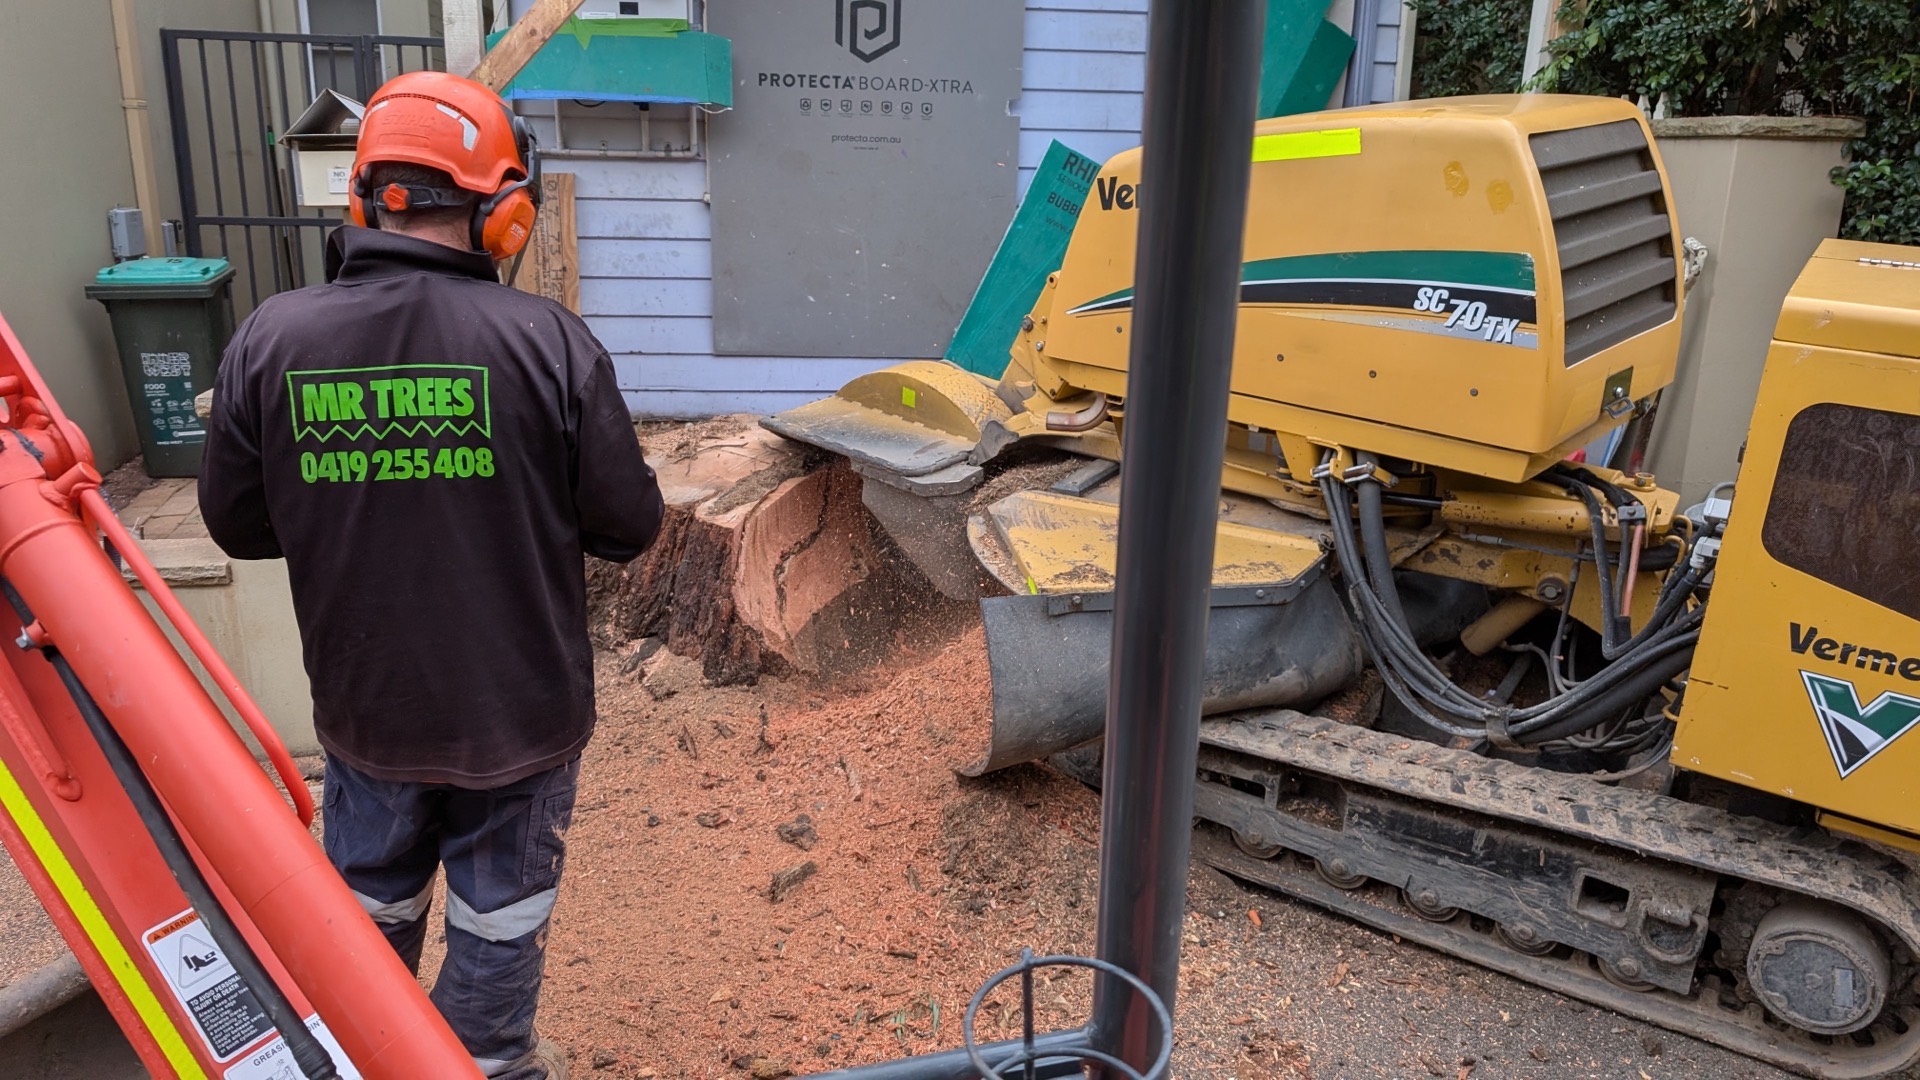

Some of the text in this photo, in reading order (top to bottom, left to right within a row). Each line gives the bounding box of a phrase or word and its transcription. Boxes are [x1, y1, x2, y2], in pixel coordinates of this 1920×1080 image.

[758, 72, 974, 95] PROTECTA BOARD-XTRA
[831, 132, 902, 144] protecta.com.au
[1061, 151, 1101, 184] RHI
[302, 377, 475, 422] MR TREES
[301, 446, 495, 484] 0419 255 408
[190, 998, 200, 1007] TO
[199, 989, 216, 1003] AVOID
[194, 982, 240, 1013] INJURY OR DEATH
[253, 1041, 287, 1067] GREASI
